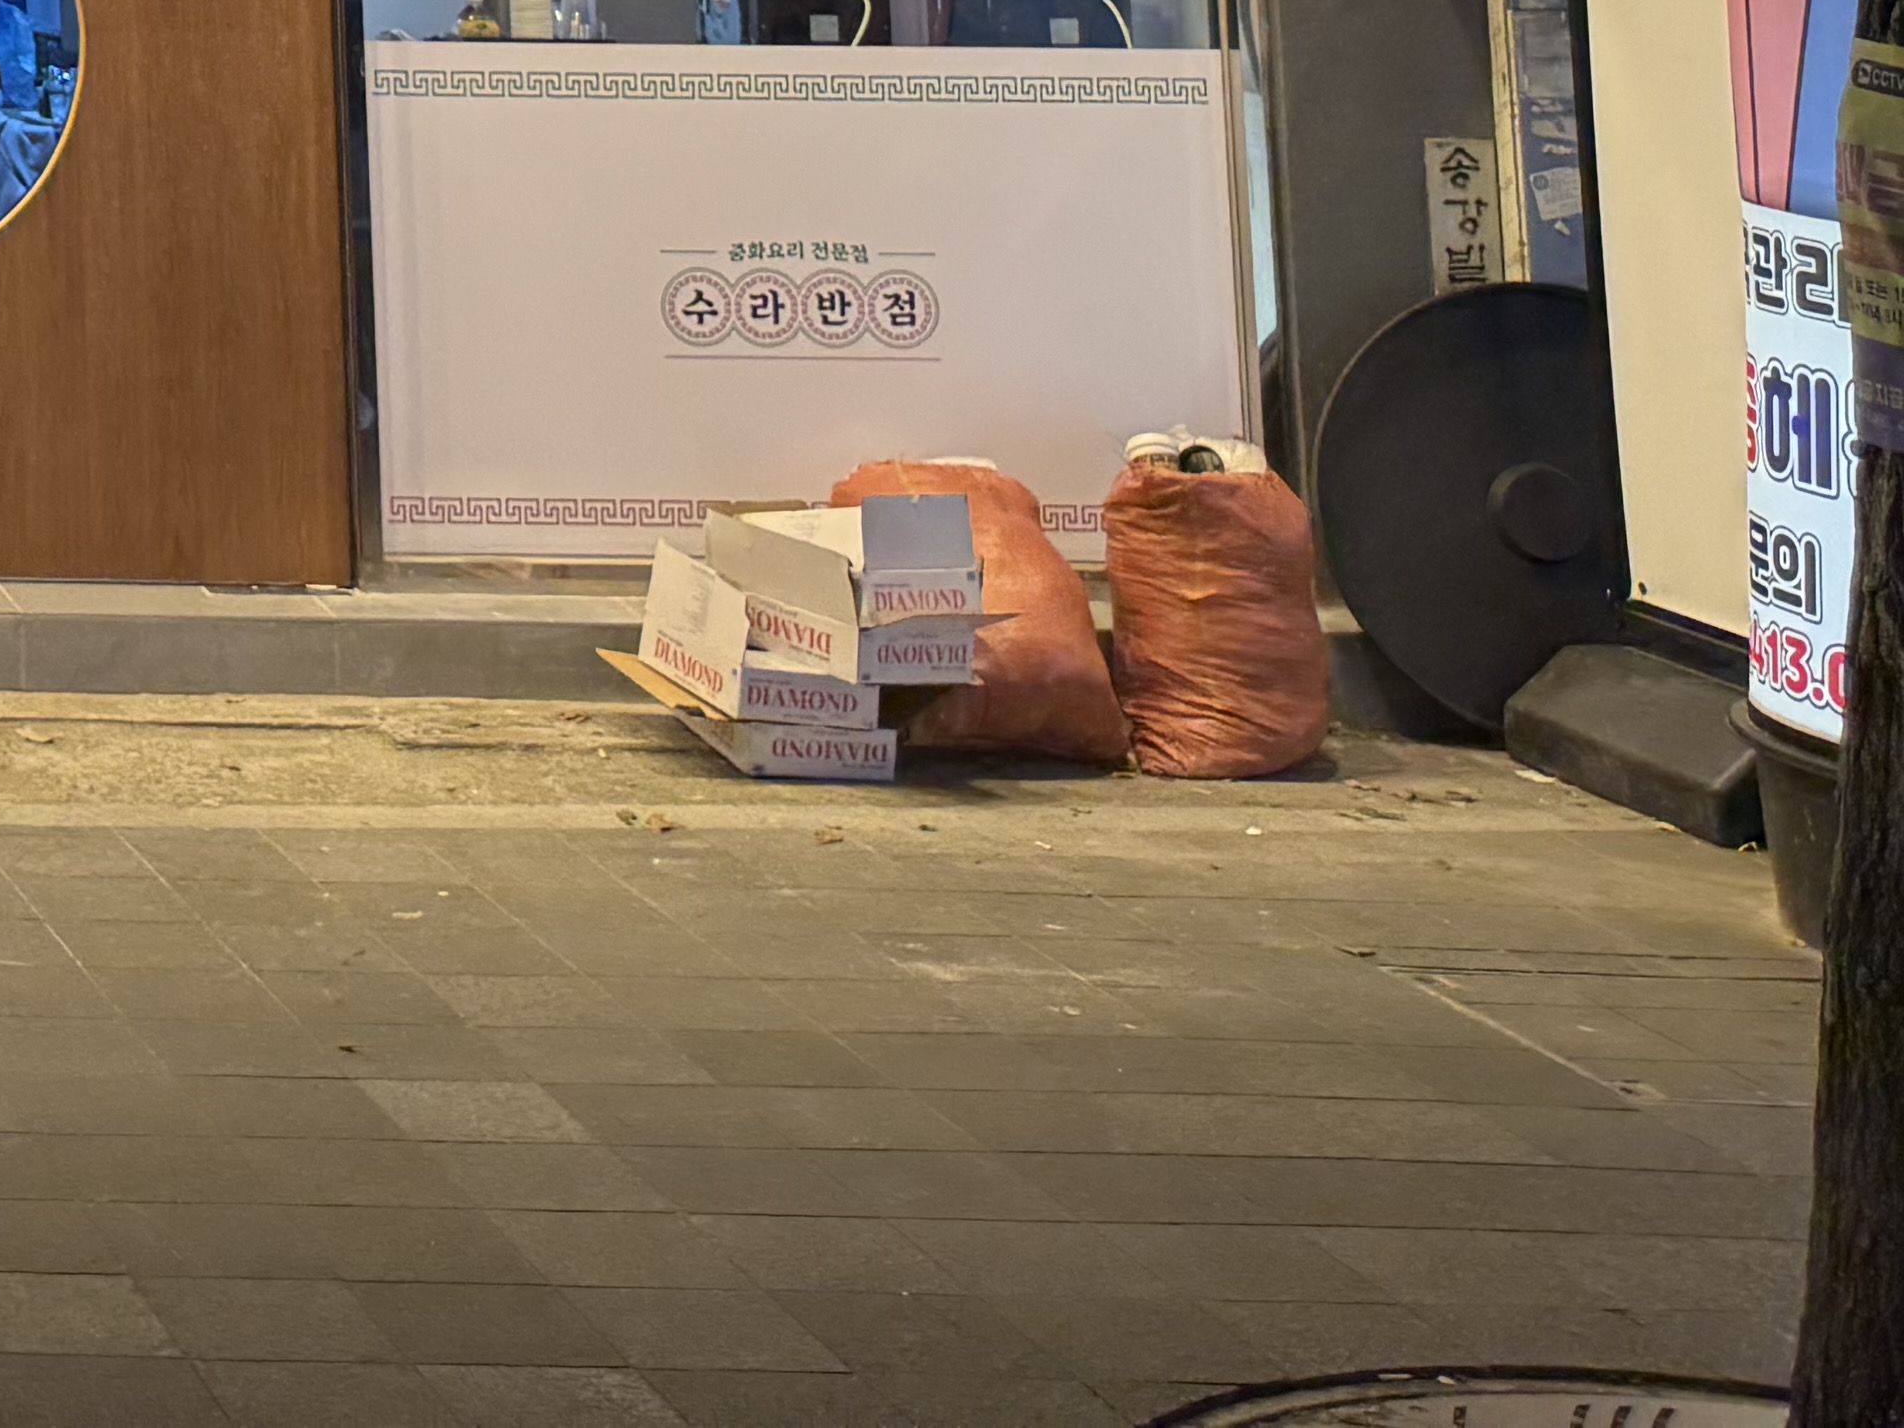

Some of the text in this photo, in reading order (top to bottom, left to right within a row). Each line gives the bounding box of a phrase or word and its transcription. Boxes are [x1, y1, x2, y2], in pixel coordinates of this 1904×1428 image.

[728, 240, 870, 264] 중화요리 전문점
[682, 289, 916, 327] 수라반점
[874, 589, 966, 612] DIAMOND
[654, 637, 723, 694] DIAMOND
[878, 644, 967, 664] DIAMOND
[748, 685, 858, 712] DIAMOND
[773, 737, 888, 761] DIAMOND
